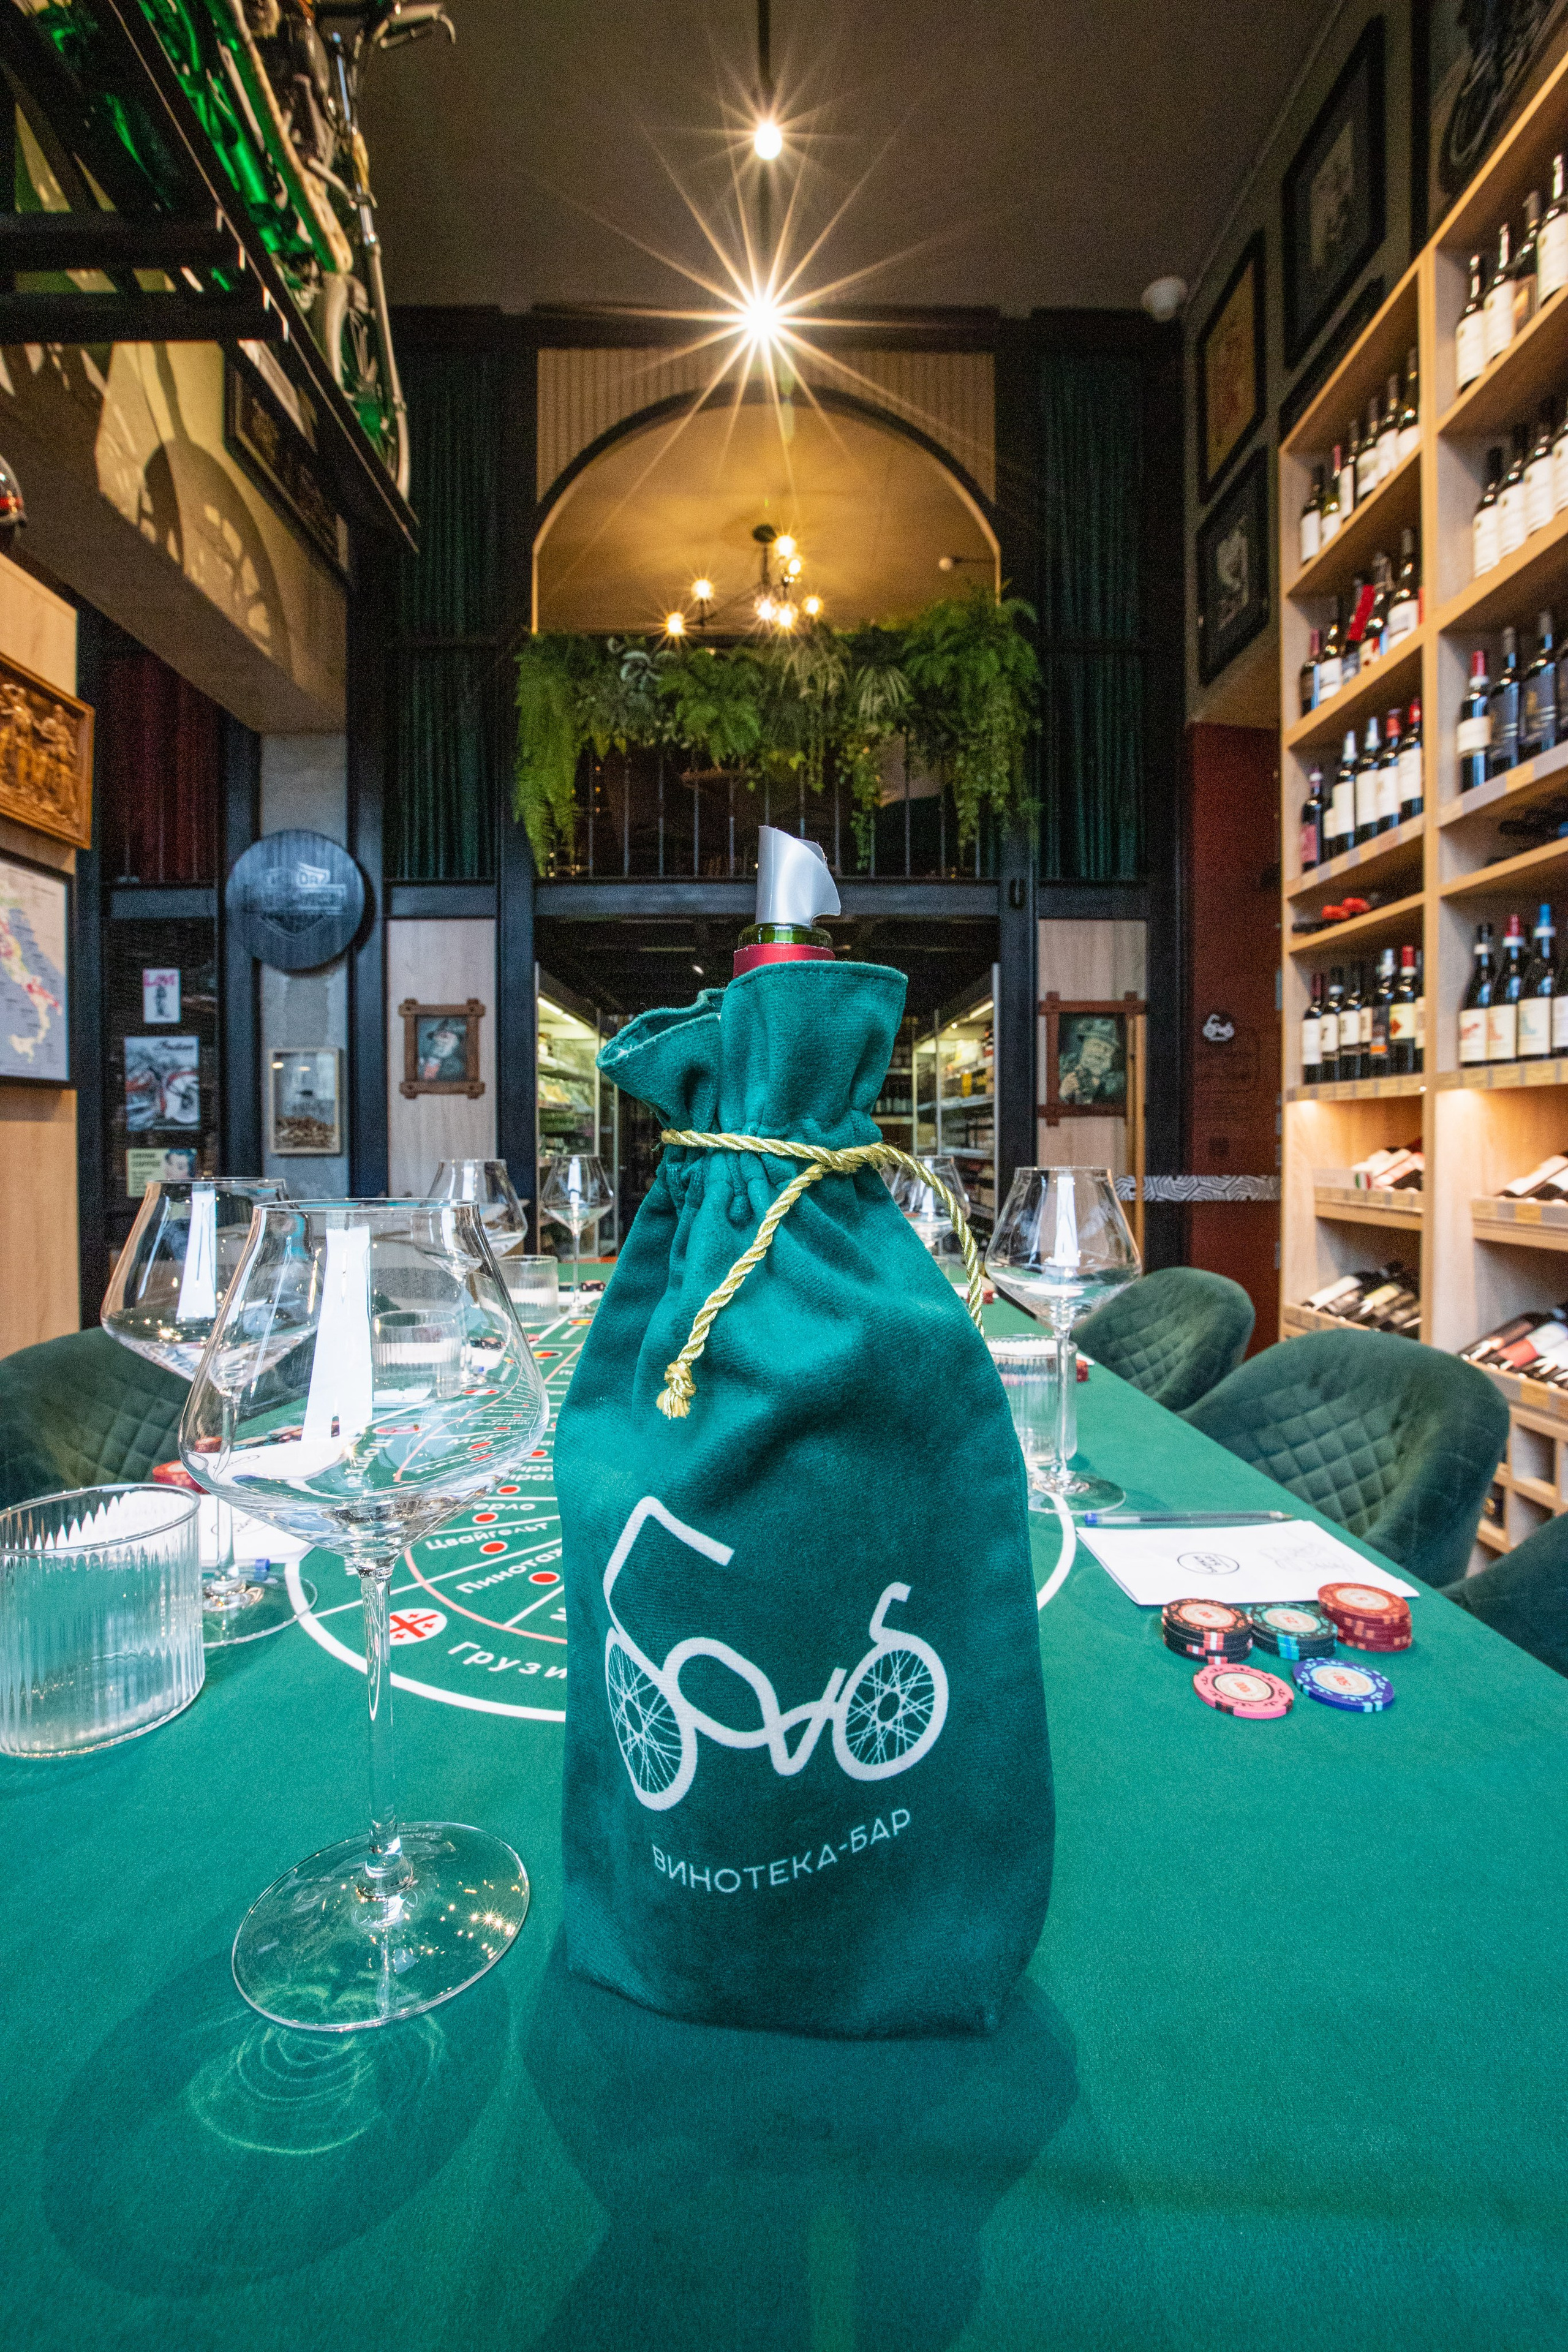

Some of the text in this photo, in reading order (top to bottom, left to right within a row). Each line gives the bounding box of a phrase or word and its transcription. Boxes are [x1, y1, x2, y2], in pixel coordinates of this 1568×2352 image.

[473, 1503, 536, 1512] ерло
[425, 1522, 548, 1550] Цвайгельт
[448, 1641, 567, 1679] Грузи
[652, 1808, 911, 1893] ВИНОТЕКА-БАР
